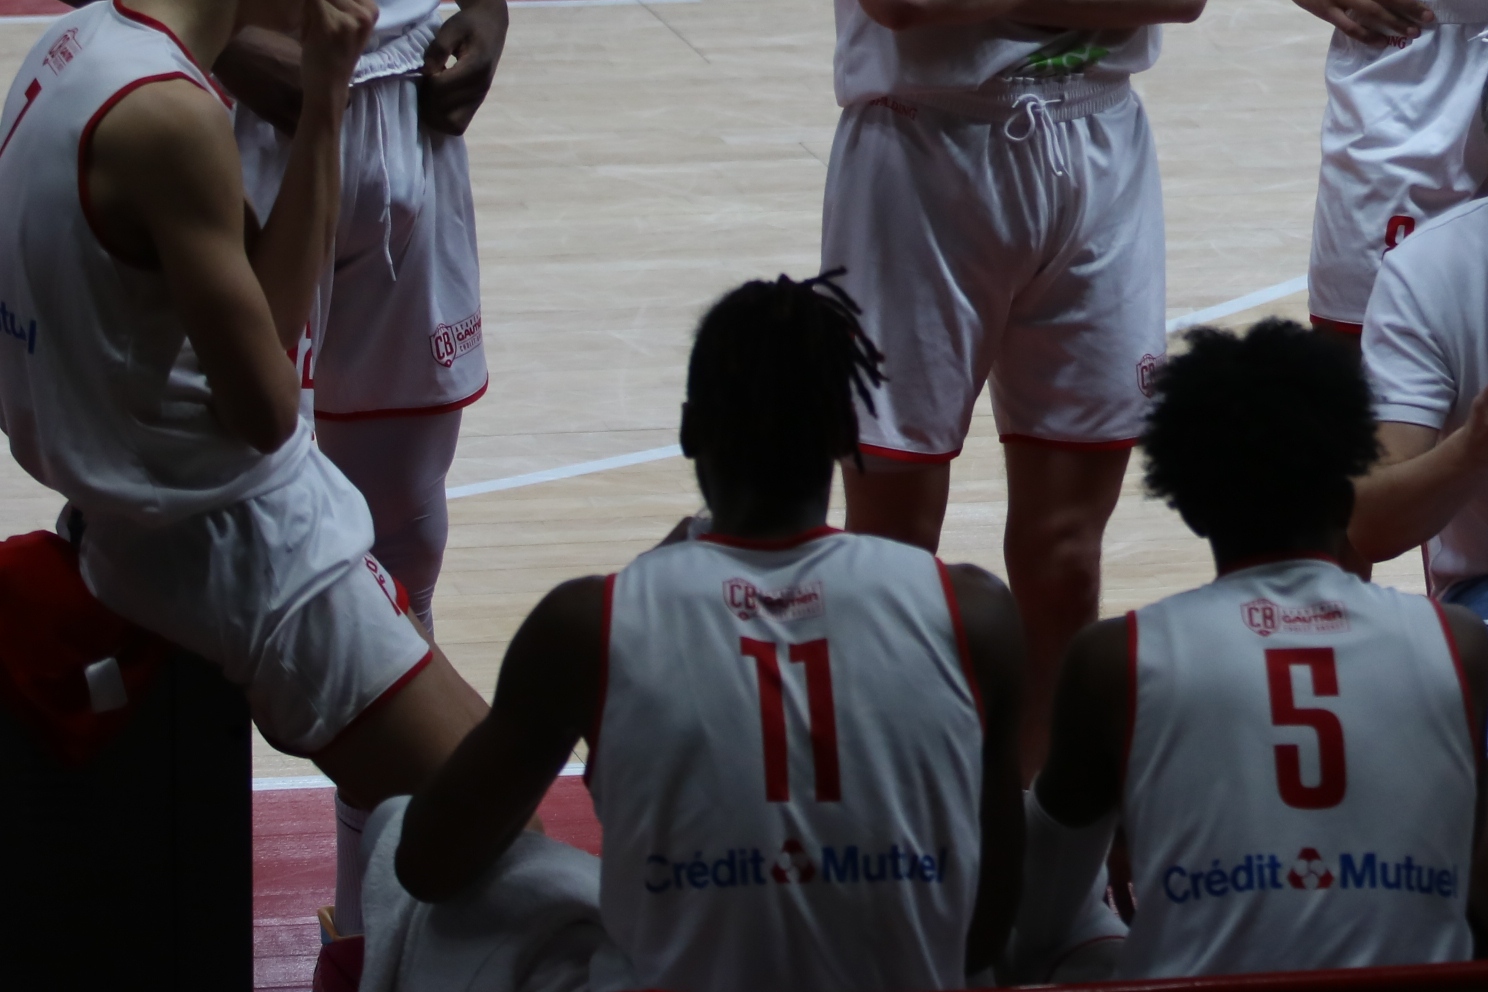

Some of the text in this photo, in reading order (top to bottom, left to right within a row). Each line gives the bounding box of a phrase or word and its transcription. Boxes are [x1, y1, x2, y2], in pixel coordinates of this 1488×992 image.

[435, 331, 454, 360] CB
[730, 584, 757, 610] CB
[1248, 606, 1276, 630] CB
[740, 636, 841, 803] 11
[1265, 647, 1347, 809] 5
[644, 847, 767, 893] Crédit
[1163, 854, 1284, 904] Crédit
